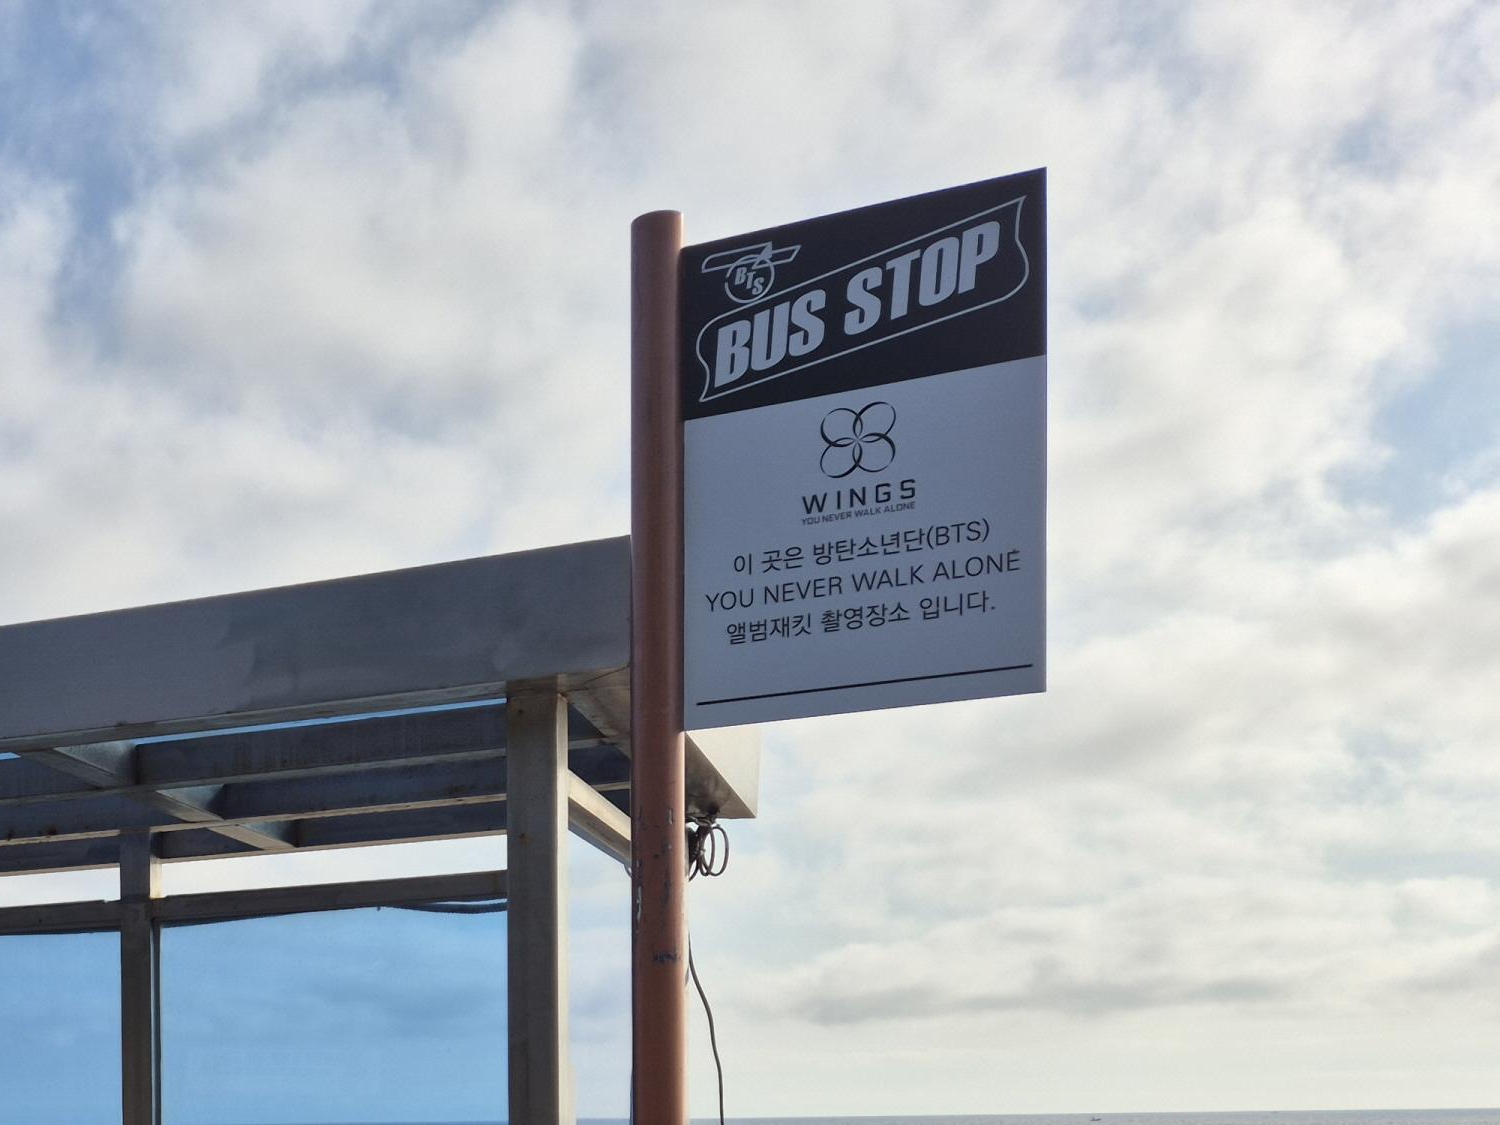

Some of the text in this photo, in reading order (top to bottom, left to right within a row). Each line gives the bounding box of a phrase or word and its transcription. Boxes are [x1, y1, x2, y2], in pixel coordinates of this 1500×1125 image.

[714, 220, 1000, 388] BUS STOP
[735, 267, 765, 296] BTS
[802, 478, 916, 514] WINGS
[802, 501, 915, 525] YOU NEVER WALK ALONE
[732, 518, 990, 576] 이 곳은 방탄소년단(BTS)
[705, 549, 1021, 612] YOU NEVER WALK ALONE
[726, 590, 996, 645] 앨범재킷 촬영장소 입니다.
